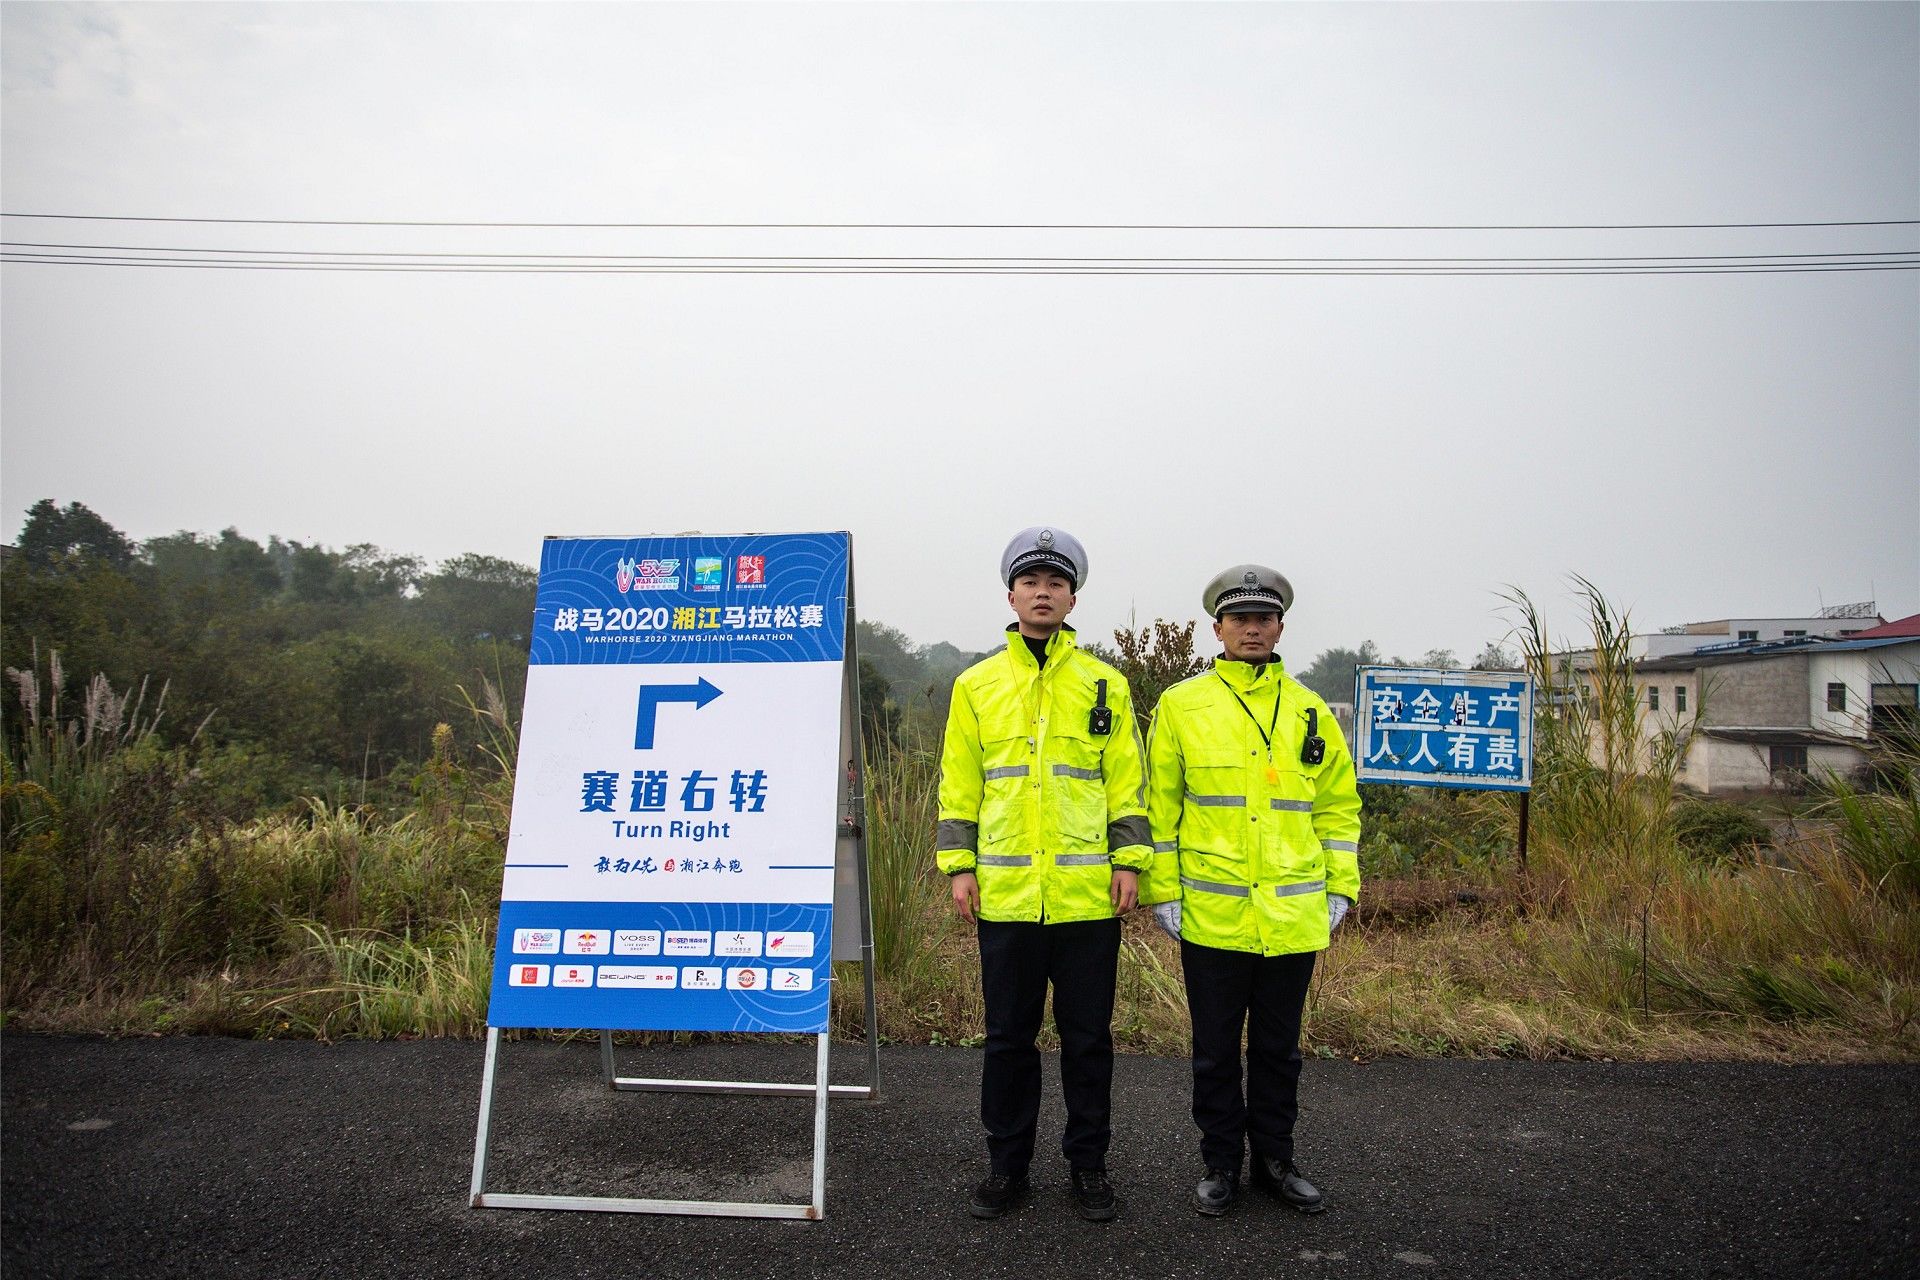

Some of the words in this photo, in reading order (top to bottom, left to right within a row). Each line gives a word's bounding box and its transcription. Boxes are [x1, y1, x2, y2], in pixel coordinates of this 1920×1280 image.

[585, 635, 641, 643] WARHORSE
[644, 635, 667, 643] 2020
[670, 634, 733, 642] XIANGJIANG
[736, 633, 793, 641] MARATHON
[1370, 730, 1517, 772] 人人有责
[579, 769, 768, 813] 赛道右转
[612, 820, 662, 838] Turn
[669, 820, 731, 842] Right
[680, 857, 743, 874] 湘江奔跑
